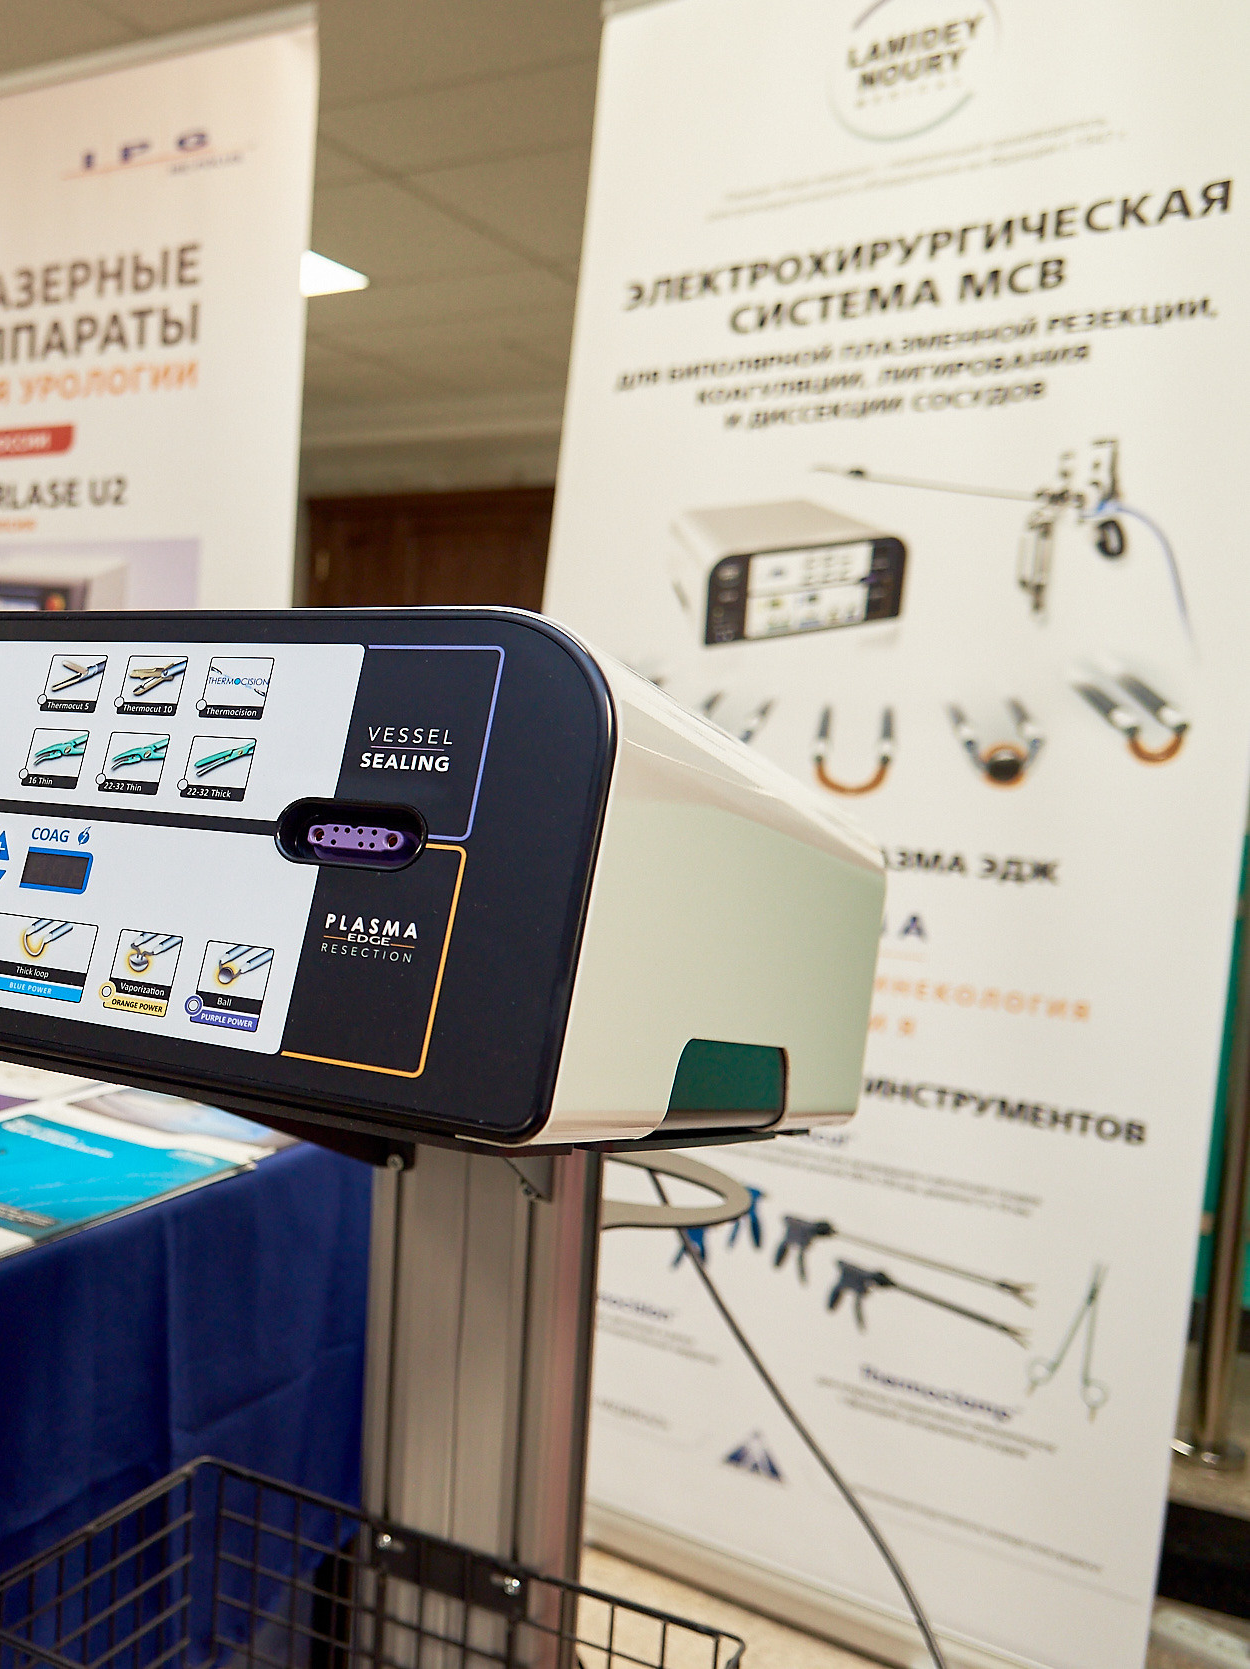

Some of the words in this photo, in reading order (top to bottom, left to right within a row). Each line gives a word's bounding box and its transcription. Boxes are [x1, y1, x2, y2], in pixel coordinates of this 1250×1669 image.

[625, 179, 1234, 311] ЭЛЕКТРОХИРУРГИЧЕСКАЯ
[728, 280, 940, 335] СИСТЕМА
[21, 361, 199, 402] УРОЛОГИИ
[88, 477, 128, 508] U2
[46, 701, 83, 711] Thermocut
[83, 702, 90, 711] 5
[123, 704, 161, 714] Thermocut
[163, 706, 173, 714] 10
[205, 707, 258, 718] Thermocision
[368, 726, 453, 745] VESSEL
[359, 752, 450, 773] SEALING
[28, 776, 37, 785] 16
[38, 776, 53, 786] Thin
[103, 781, 125, 791] 22-32
[126, 782, 142, 792] Thin
[186, 787, 209, 798] 22-32
[211, 788, 231, 798] Thick
[31, 827, 70, 844] COAG
[979, 856, 1060, 884] ЭДЖ
[324, 912, 418, 940] PLASMA
[347, 933, 392, 947] EDGE
[320, 942, 413, 964] RESECTION
[15, 965, 32, 977] Thick
[33, 967, 49, 980] loop
[9, 981, 27, 992] BLUE
[27, 983, 52, 995] POWER
[120, 981, 165, 998] Vaporization
[111, 998, 138, 1010] ORANGE
[139, 1002, 163, 1014] POWER
[216, 996, 232, 1007] Ball
[200, 1012, 227, 1025] PURPLE
[227, 1016, 253, 1029] POWER
[864, 1076, 1146, 1146] ИНСТРУМЕНТОВ
